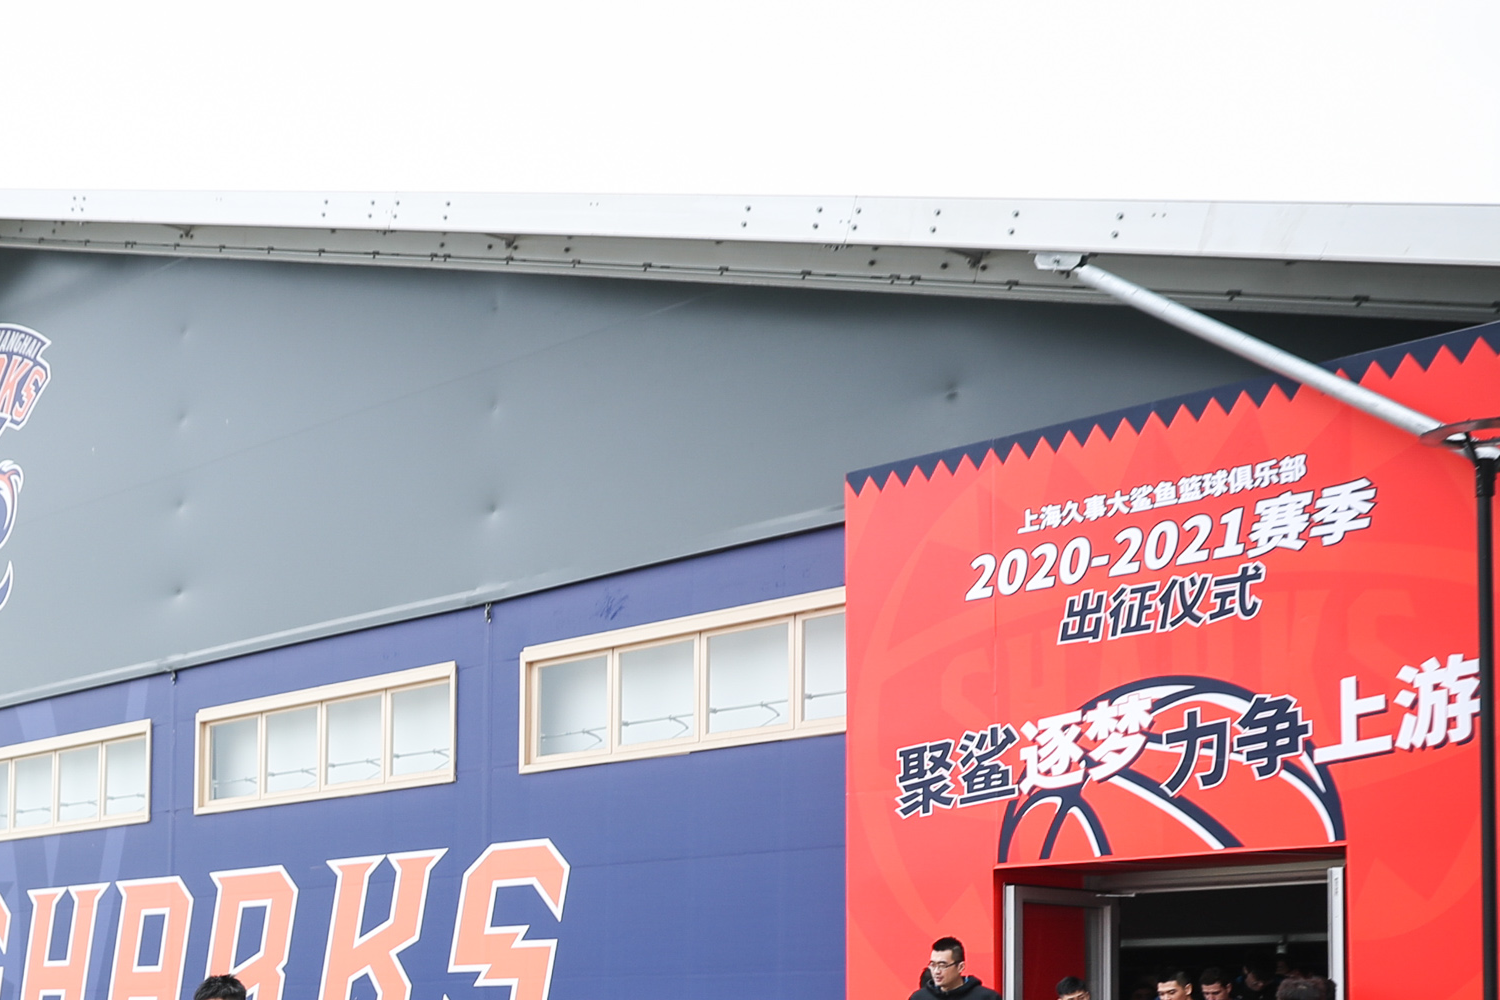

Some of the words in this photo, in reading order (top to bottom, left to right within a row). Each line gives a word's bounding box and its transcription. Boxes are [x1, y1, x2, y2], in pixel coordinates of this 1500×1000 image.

[1016, 453, 1307, 534] 上海久事大鲨鱼篮球俱乐部
[964, 477, 1378, 601] 2020-2021赛季
[1056, 562, 1266, 645] 出征仪式
